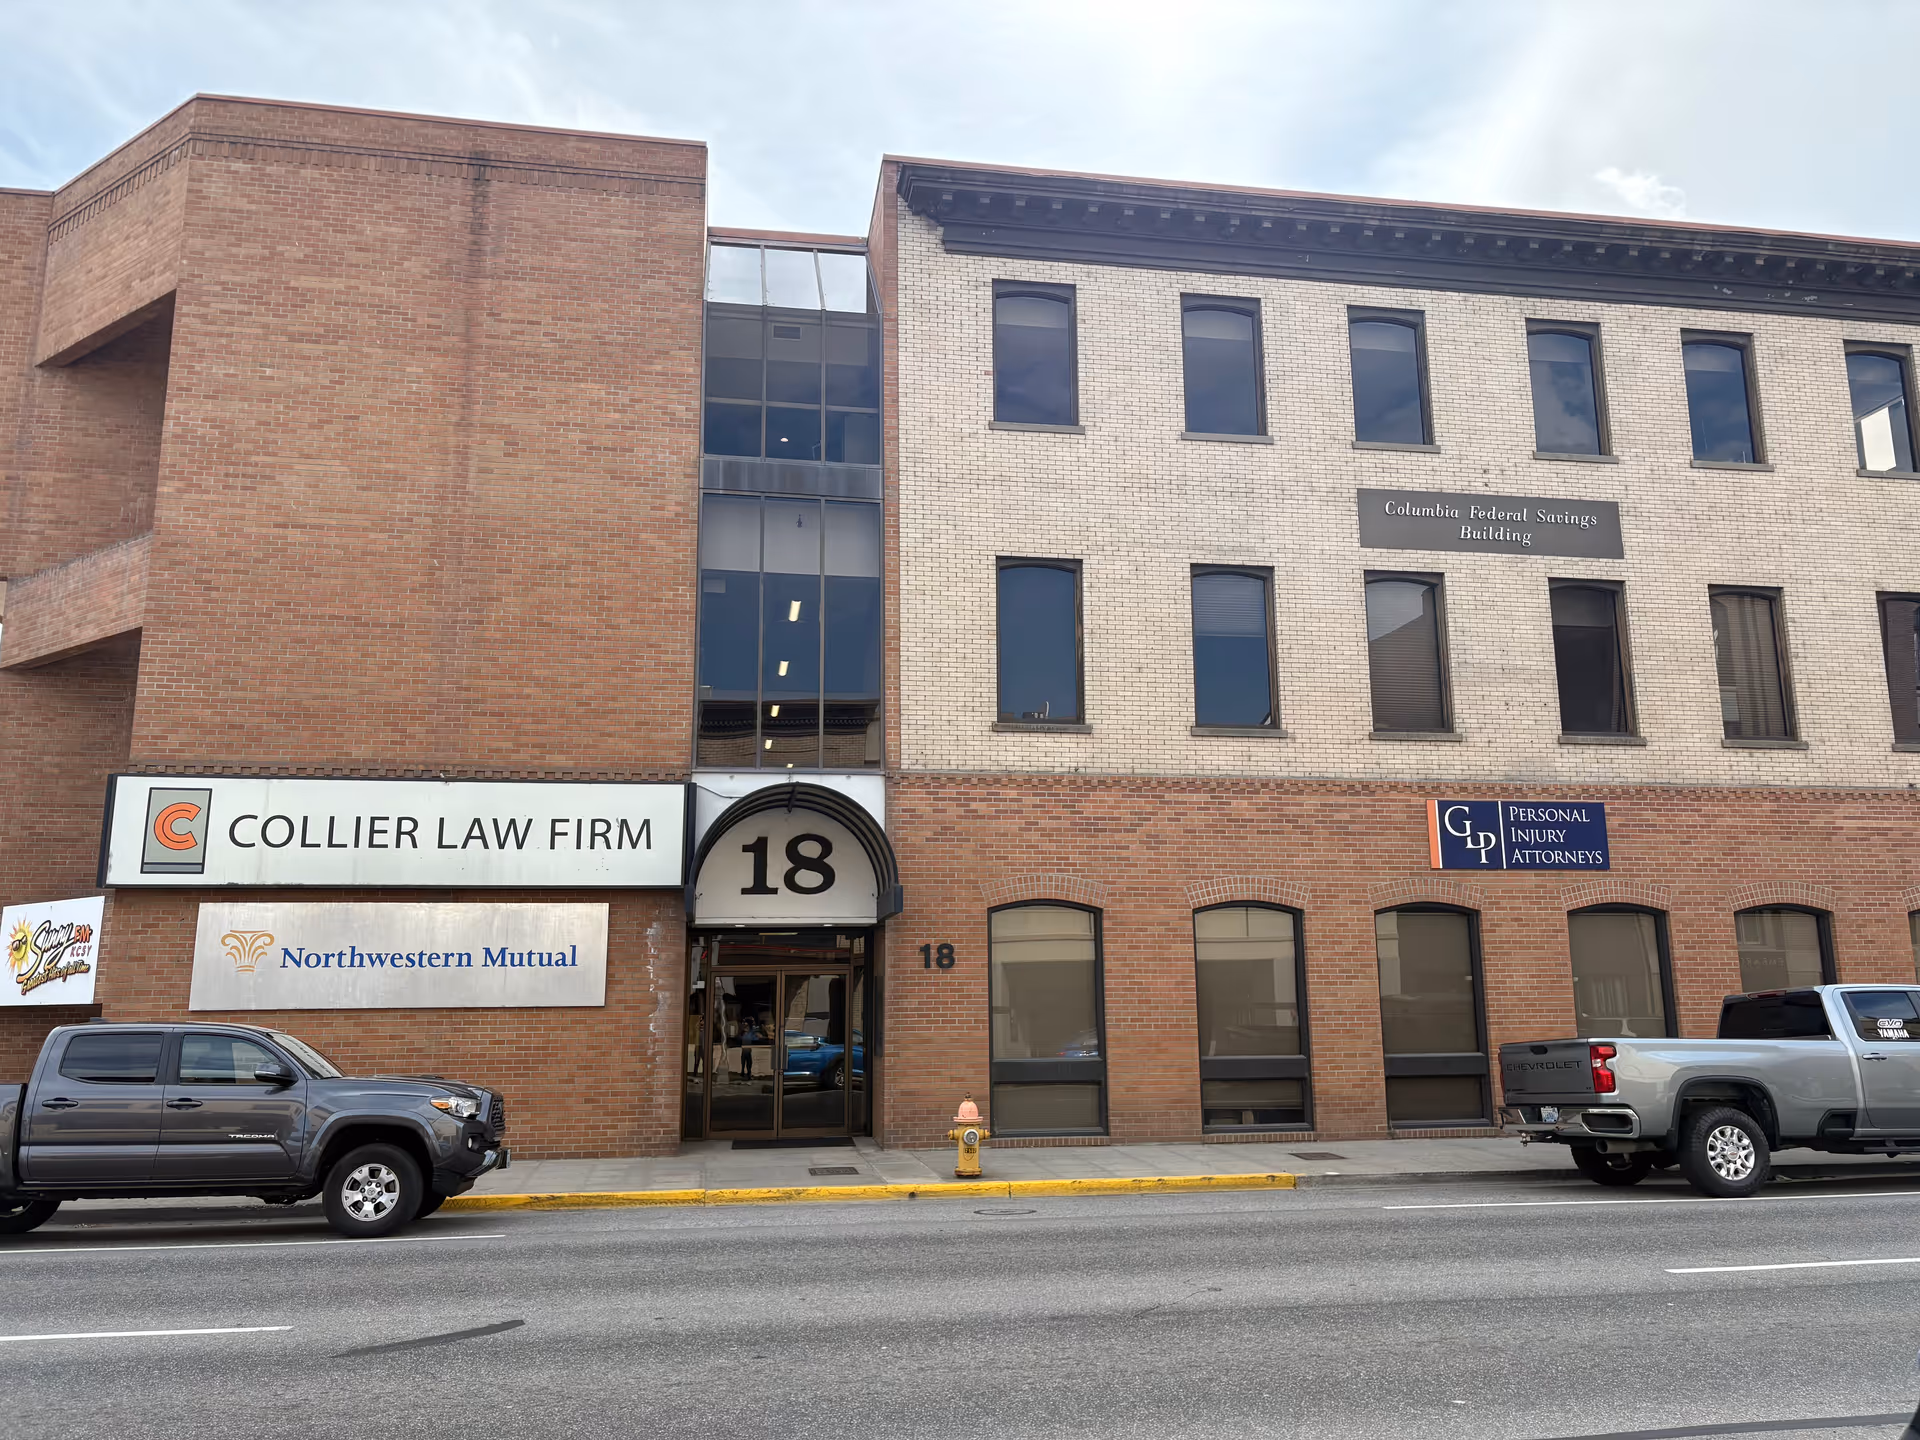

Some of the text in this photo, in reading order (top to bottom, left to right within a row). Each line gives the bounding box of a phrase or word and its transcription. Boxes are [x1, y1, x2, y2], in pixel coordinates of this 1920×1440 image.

[1384, 500, 1598, 530] Columbia Federal Savings
[1459, 525, 1532, 547] Building
[1509, 806, 1591, 822] PERSONAL
[228, 814, 652, 850] COLLIER LAW FIRM
[1443, 805, 1496, 864] GLP
[1511, 826, 1567, 846] INJURY
[740, 832, 836, 896] 18
[1511, 848, 1603, 864] ATTORNEYS
[74, 924, 93, 944] FM
[70, 944, 92, 957] KCSY
[279, 944, 578, 969] Northwestern Mutual
[919, 942, 956, 971] 18
[1877, 1029, 1909, 1038] YAMAHA
[1505, 1060, 1583, 1072] CHEVROLET
